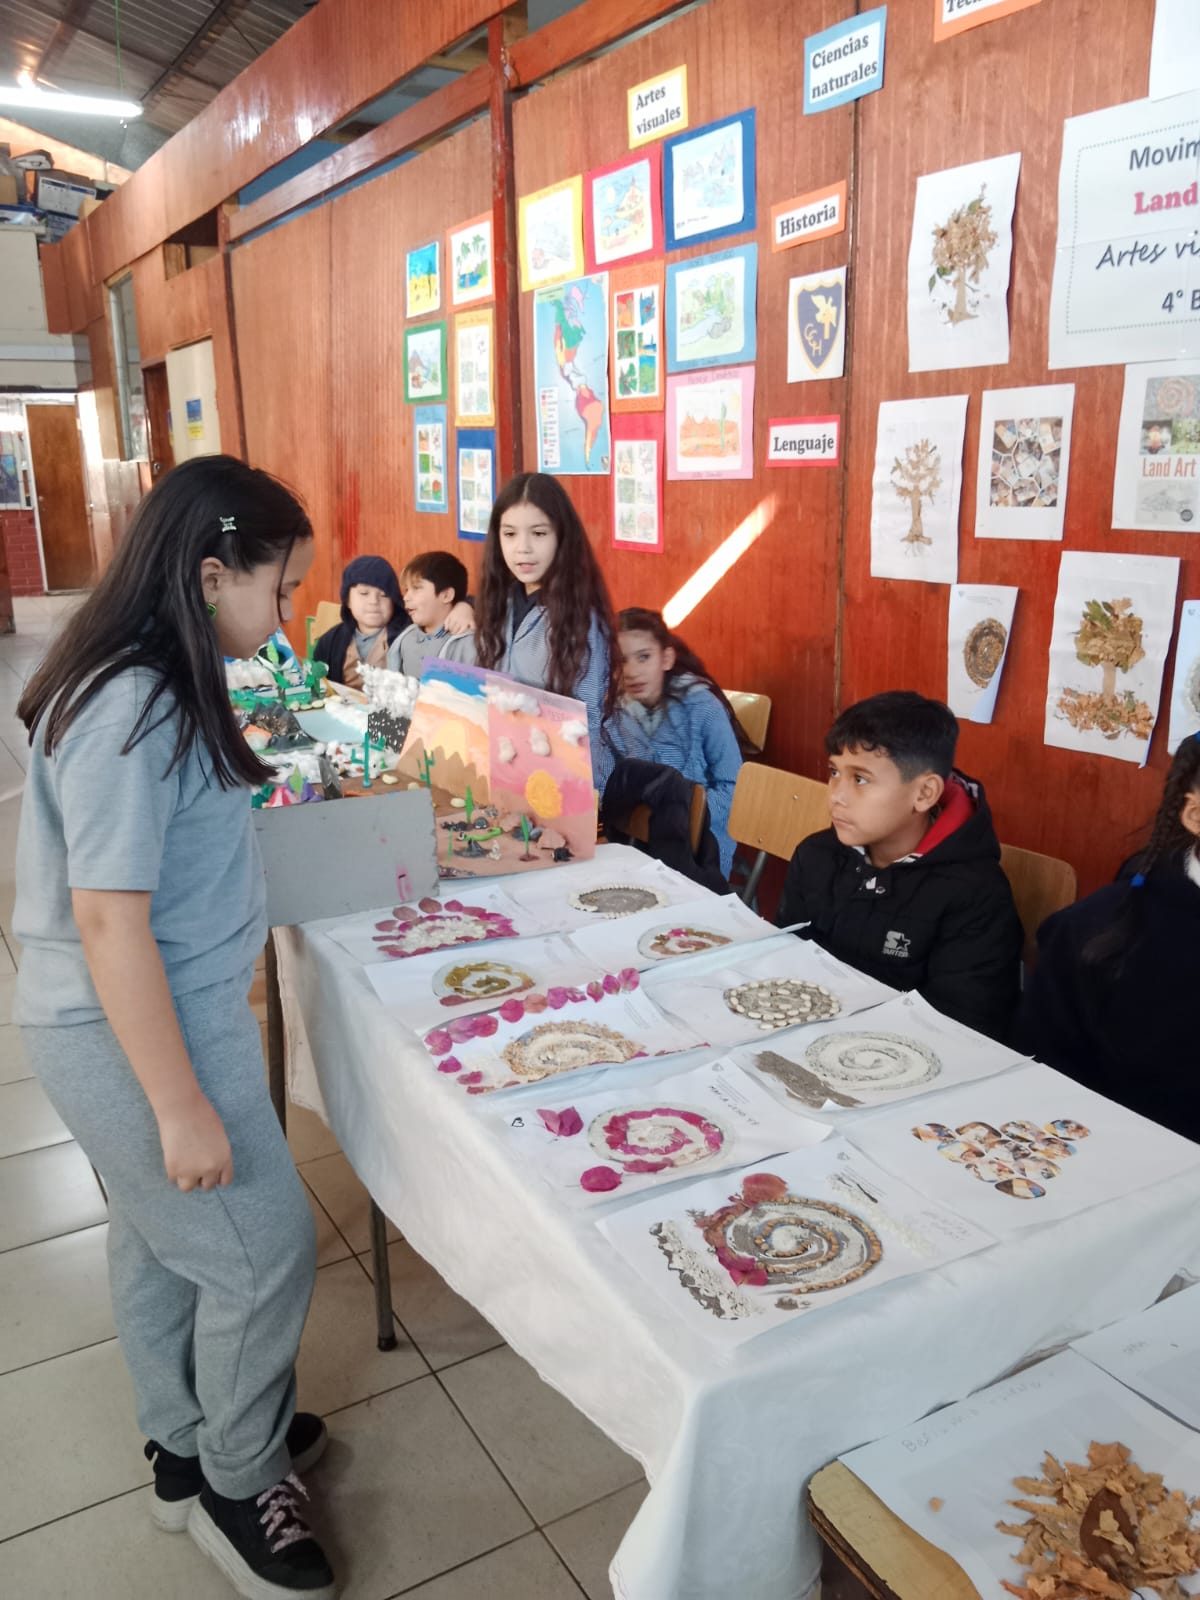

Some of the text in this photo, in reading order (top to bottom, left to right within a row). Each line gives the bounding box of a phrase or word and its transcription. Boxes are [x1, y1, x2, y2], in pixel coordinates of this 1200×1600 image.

[812, 35, 869, 69] Ciencias
[811, 61, 877, 98] naturales
[636, 86, 666, 111] Artes
[636, 106, 681, 135] visuales
[1134, 182, 1198, 214] Land
[780, 204, 836, 237] Historia
[1095, 241, 1167, 270] Artes
[1161, 290, 1183, 313] 4°
[773, 434, 834, 455] Lenguaje
[1142, 457, 1198, 478] Land Art
